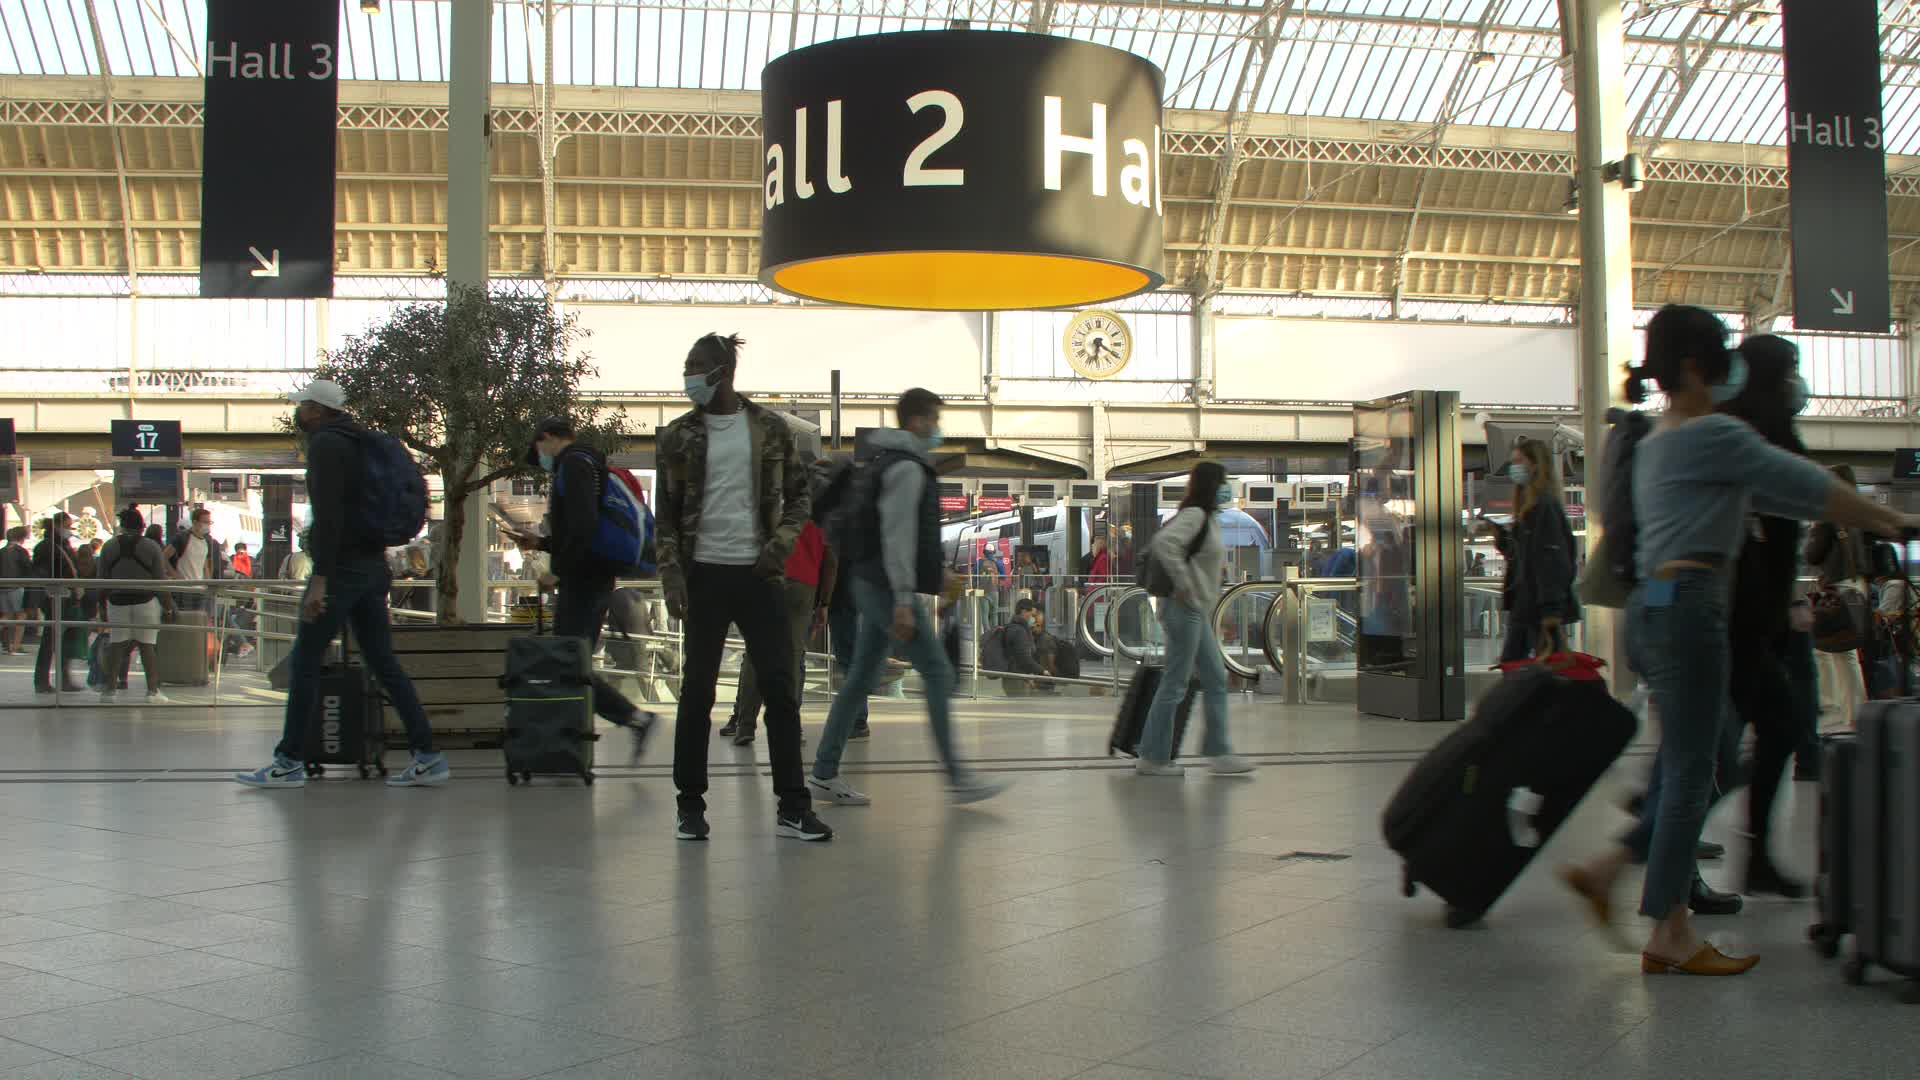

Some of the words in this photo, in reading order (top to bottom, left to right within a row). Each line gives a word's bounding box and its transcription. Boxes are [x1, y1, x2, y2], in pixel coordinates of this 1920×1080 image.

[206, 40, 295, 80] Hall
[308, 43, 334, 81] 3
[1790, 111, 1855, 148] Hall
[1864, 117, 1881, 150] 3
[763, 99, 852, 213] all
[903, 89, 965, 187] 2
[135, 432, 159, 449] 17
